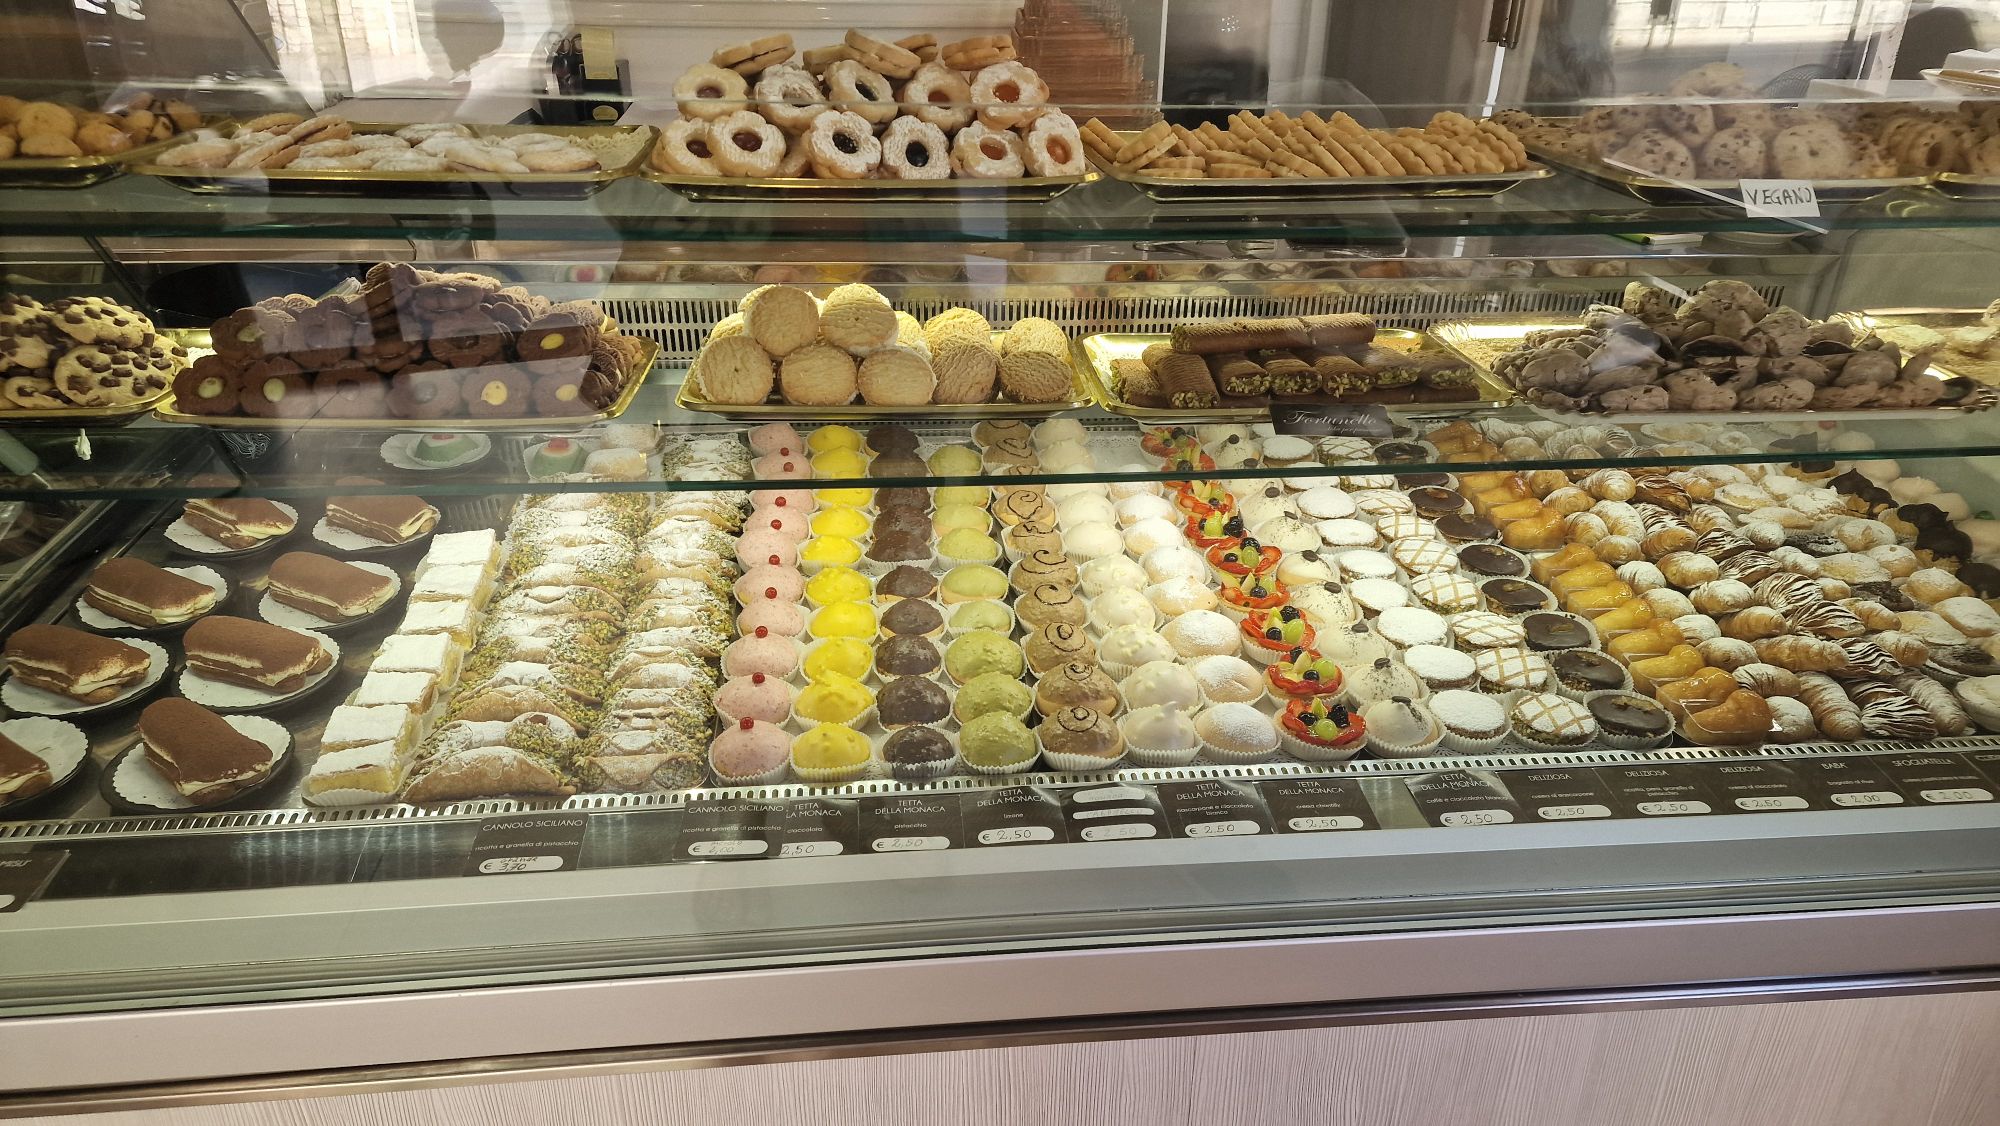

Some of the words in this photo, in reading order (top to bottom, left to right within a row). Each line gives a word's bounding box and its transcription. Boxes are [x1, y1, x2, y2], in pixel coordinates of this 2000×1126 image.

[1745, 187, 1812, 206] VEGANO
[1440, 773, 1467, 781] TETTA
[1195, 783, 1221, 791] TETTA
[1421, 782, 1449, 791] DELLA
[999, 788, 1024, 797] TETTA
[1176, 792, 1202, 800] DELLA
[1203, 790, 1245, 798] MONACA
[977, 799, 1003, 807] DELLA
[1004, 795, 1046, 803] MONACA
[1836, 796, 1846, 804] €
[1926, 793, 1936, 801] €
[794, 802, 819, 810] TETTA
[898, 799, 923, 807] TETTA
[688, 806, 737, 814] CANNOLO
[739, 804, 785, 812] SICILIANO
[875, 807, 902, 815] DELLA
[799, 810, 842, 818] MONACA
[1444, 816, 1453, 824] €
[482, 821, 534, 831] CANNOLO
[536, 819, 584, 828] SICILIANO
[1293, 821, 1301, 829] €
[1085, 830, 1094, 838] €
[1189, 827, 1198, 835] €
[996, 830, 1032, 841] 2,50
[475, 843, 499, 851] ricotta
[505, 841, 534, 849] granella
[693, 845, 701, 853] €
[781, 844, 815, 856] 2,50
[484, 862, 493, 870] €
[500, 863, 527, 872] 3,70
